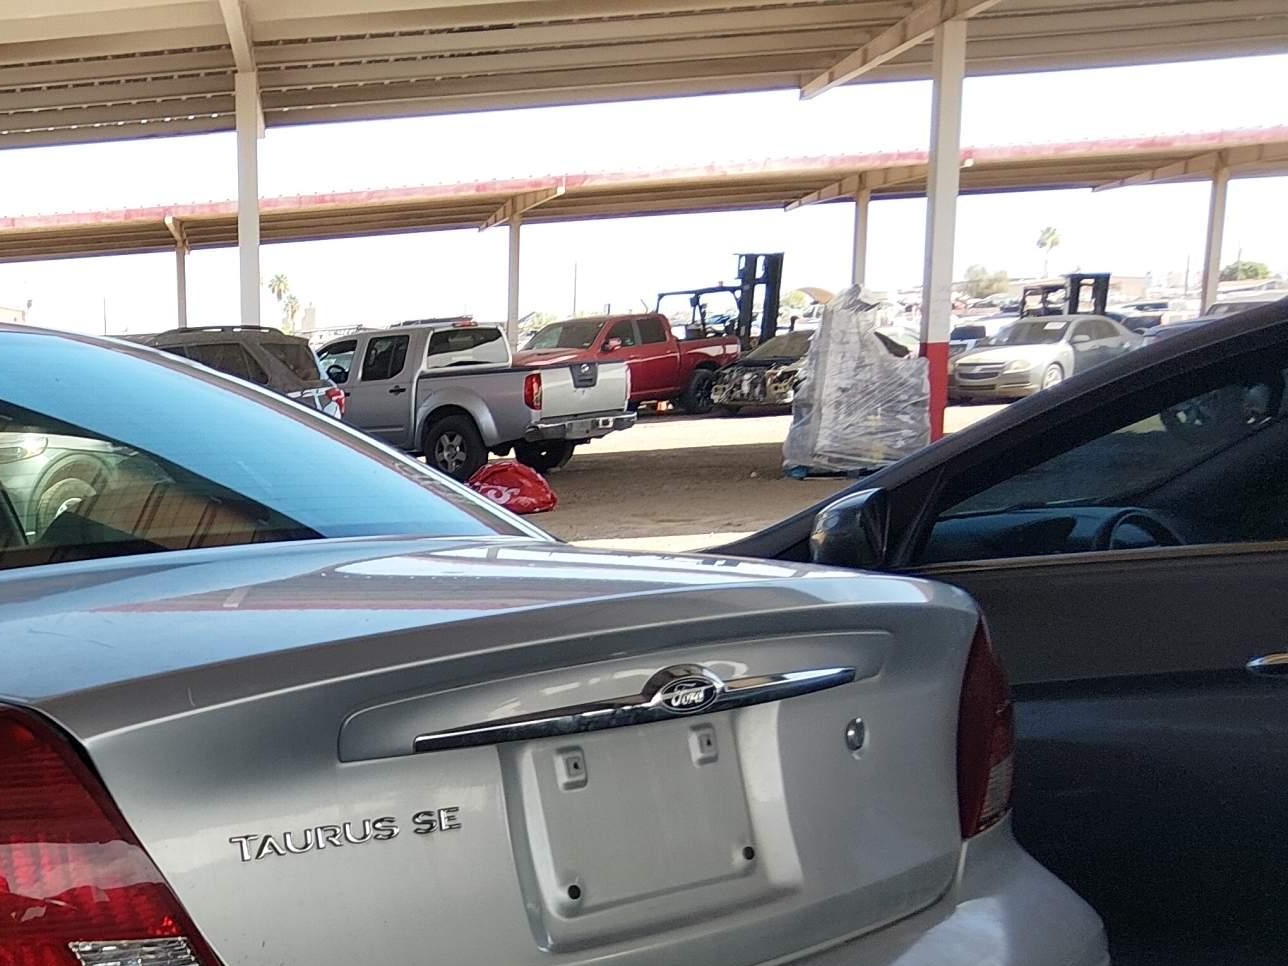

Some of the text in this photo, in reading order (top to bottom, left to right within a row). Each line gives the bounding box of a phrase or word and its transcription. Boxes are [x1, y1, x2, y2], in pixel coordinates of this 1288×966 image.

[664, 681, 713, 707] Ford
[229, 806, 462, 862] TAURUS SE
